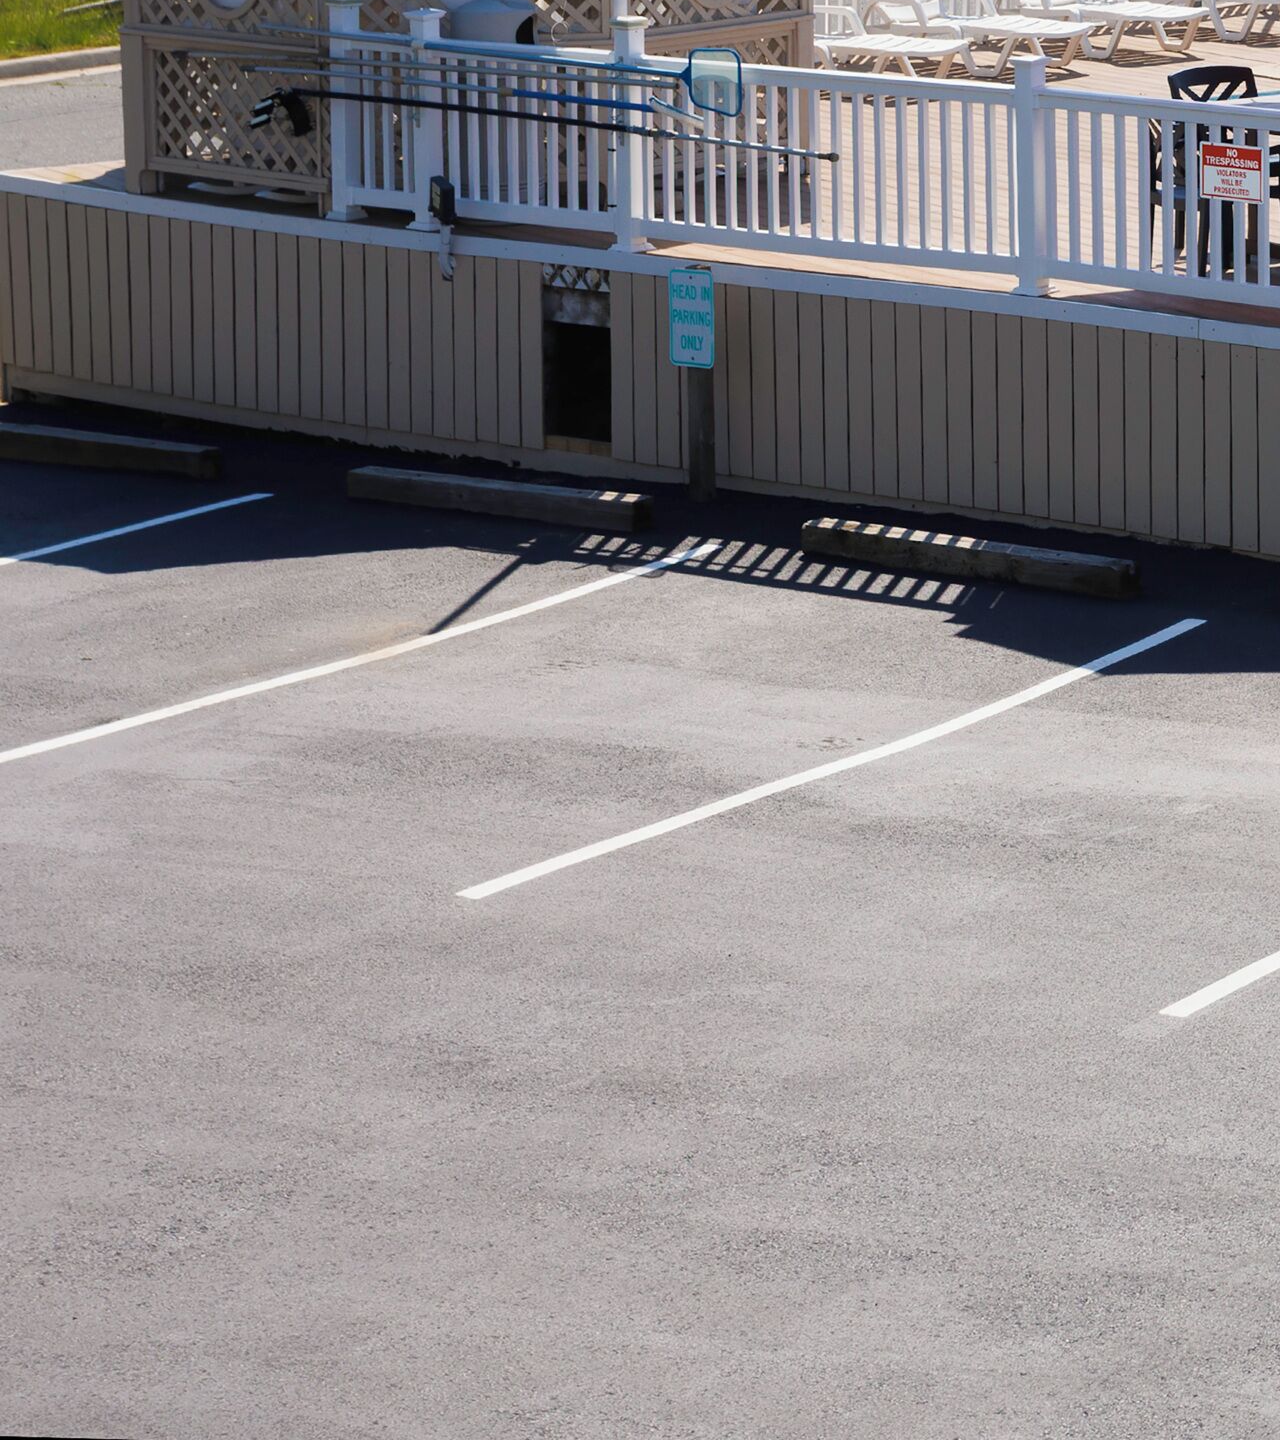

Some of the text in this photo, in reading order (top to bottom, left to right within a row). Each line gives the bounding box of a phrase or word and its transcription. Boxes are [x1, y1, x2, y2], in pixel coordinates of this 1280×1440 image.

[1226, 148, 1238, 158] NO
[1206, 155, 1259, 169] TRESPASSING
[1216, 169, 1247, 179] VIOLATORS
[1220, 179, 1235, 187] WILL
[1213, 186, 1250, 197] PROSECUTED
[672, 284, 710, 302] HEAD IN
[672, 308, 711, 327] PARKING
[680, 334, 704, 351] ONLY
